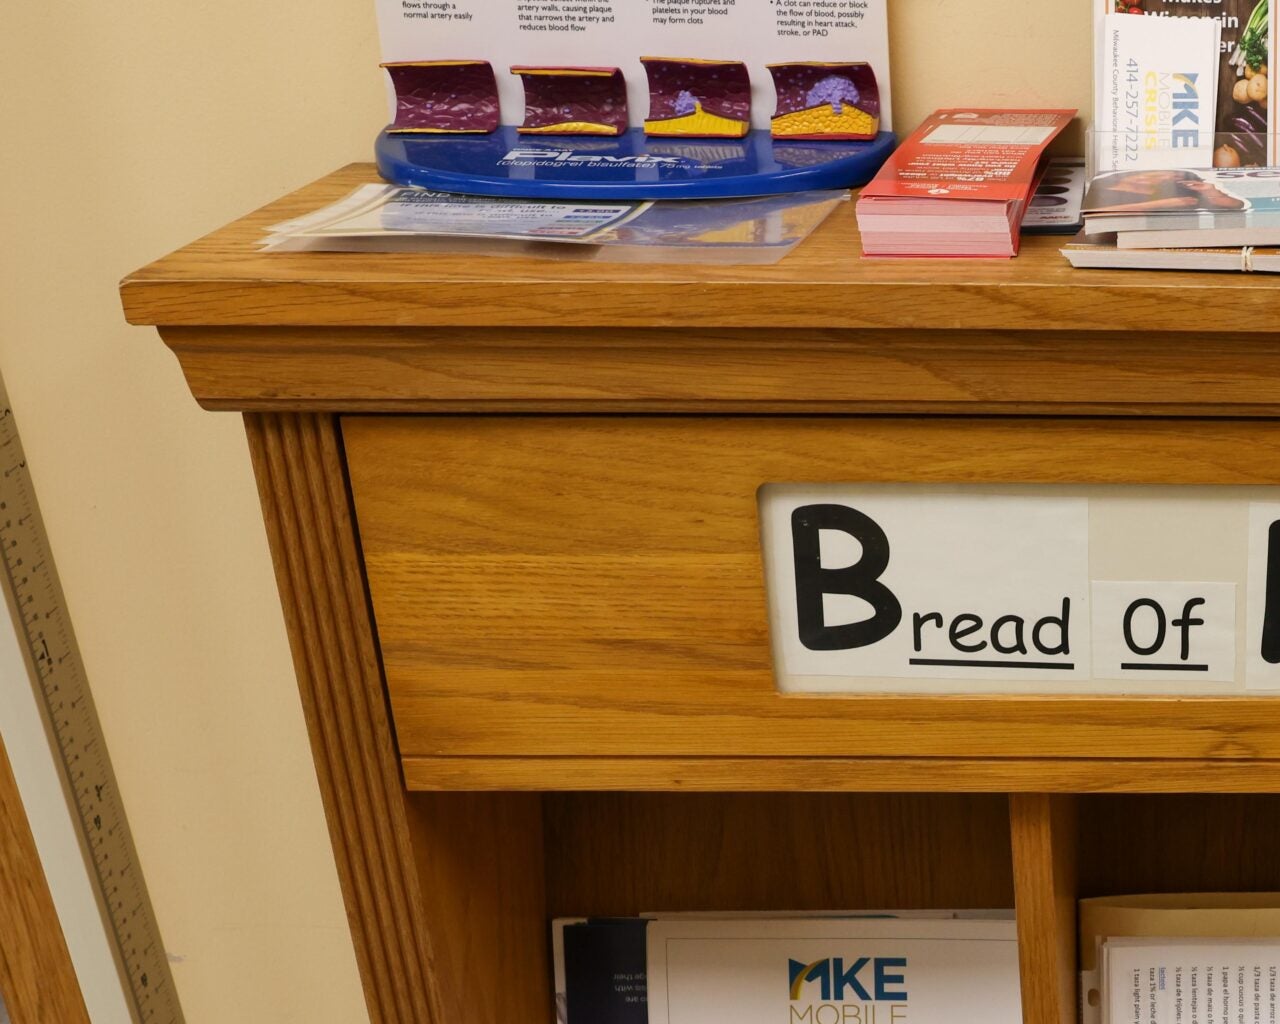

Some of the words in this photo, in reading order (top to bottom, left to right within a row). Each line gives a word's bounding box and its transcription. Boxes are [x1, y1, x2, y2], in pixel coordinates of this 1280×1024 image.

[430, 12, 451, 20] artery
[453, 12, 472, 20] easily
[519, 23, 547, 32] reduces
[548, 23, 569, 32] blood
[570, 23, 585, 31] flow
[668, 15, 685, 23] form
[686, 16, 703, 24] clots
[777, 28, 800, 36] stroke,
[802, 28, 810, 36] or
[812, 28, 828, 36] PAD
[1111, 69, 1119, 95] County
[1126, 58, 1138, 162] 414-257-7222
[1144, 70, 1157, 150] CRISIS
[1172, 72, 1199, 148] MKE
[502, 150, 680, 162] Plavix
[791, 503, 1071, 658] Bread
[788, 958, 908, 1000] MKE
